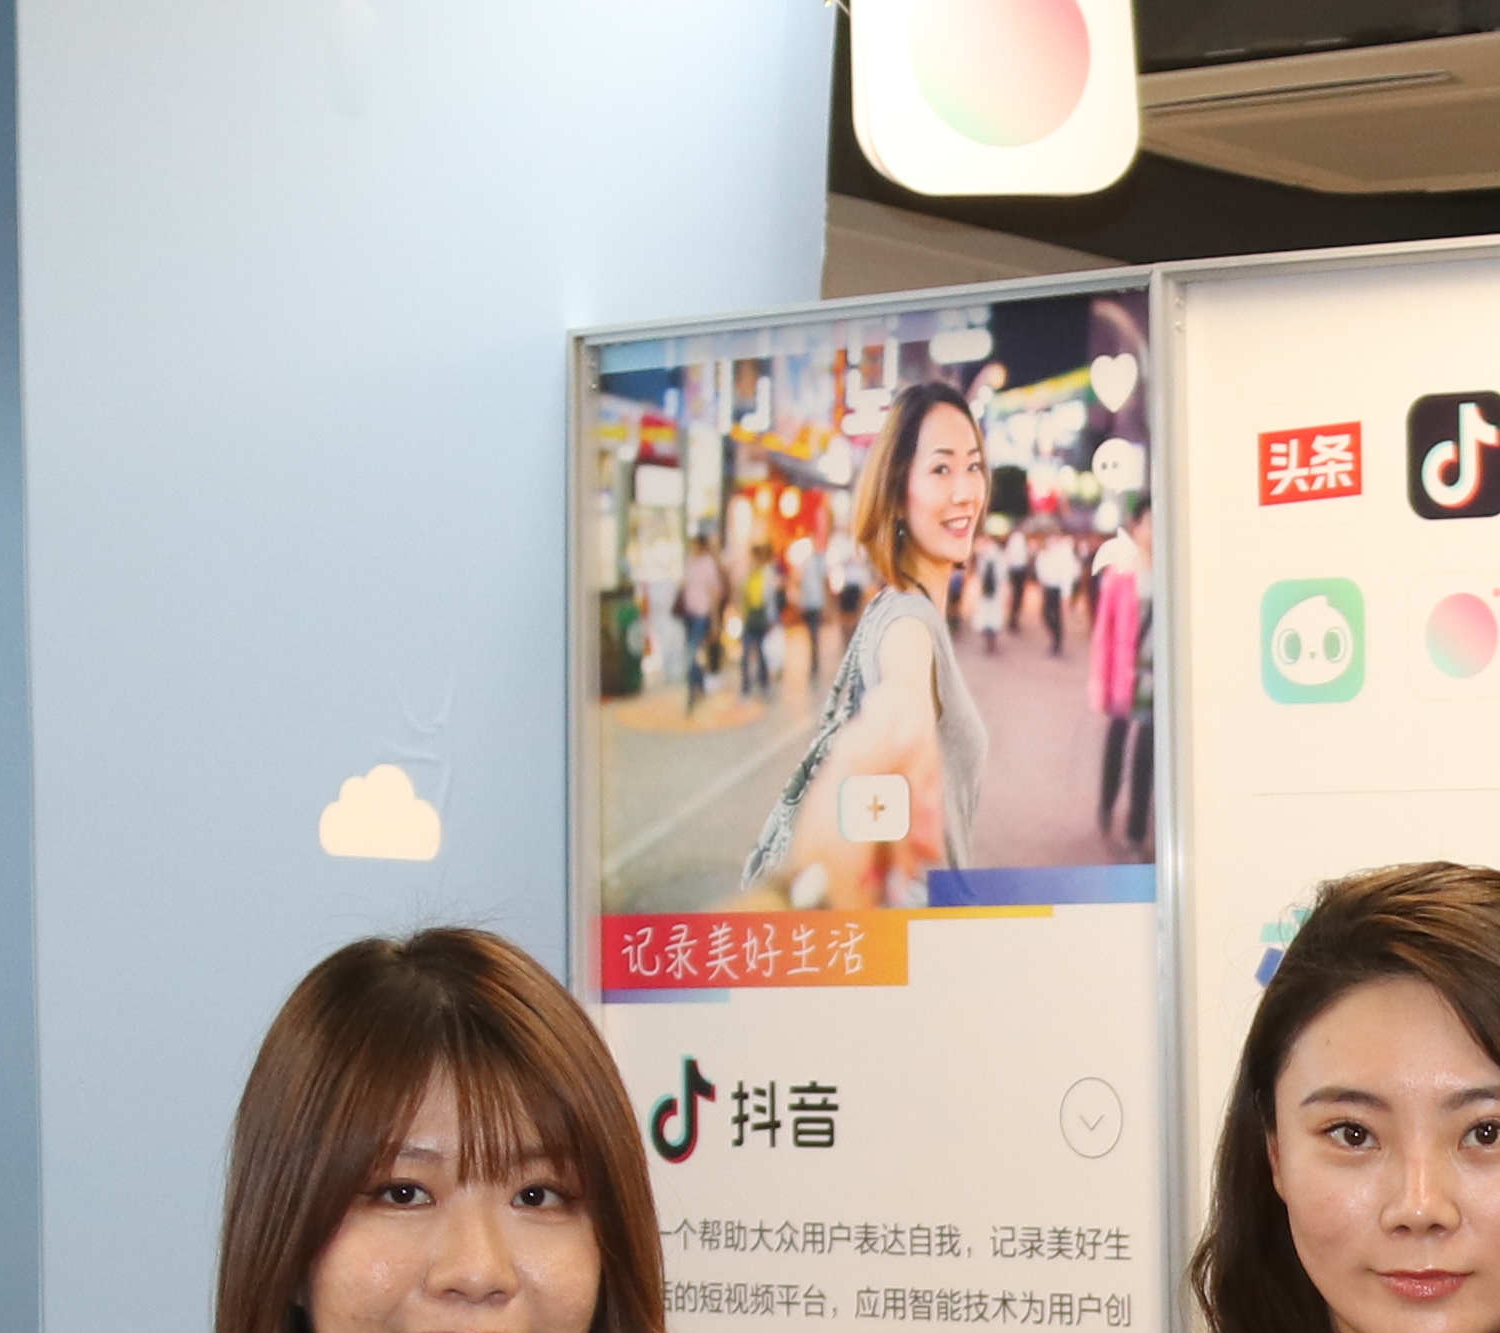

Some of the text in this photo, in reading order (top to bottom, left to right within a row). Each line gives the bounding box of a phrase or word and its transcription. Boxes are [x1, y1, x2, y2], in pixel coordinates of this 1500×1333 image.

[1267, 433, 1355, 495] 头条
[621, 922, 867, 980] 记录美好生活
[731, 1080, 839, 1148] 抖音
